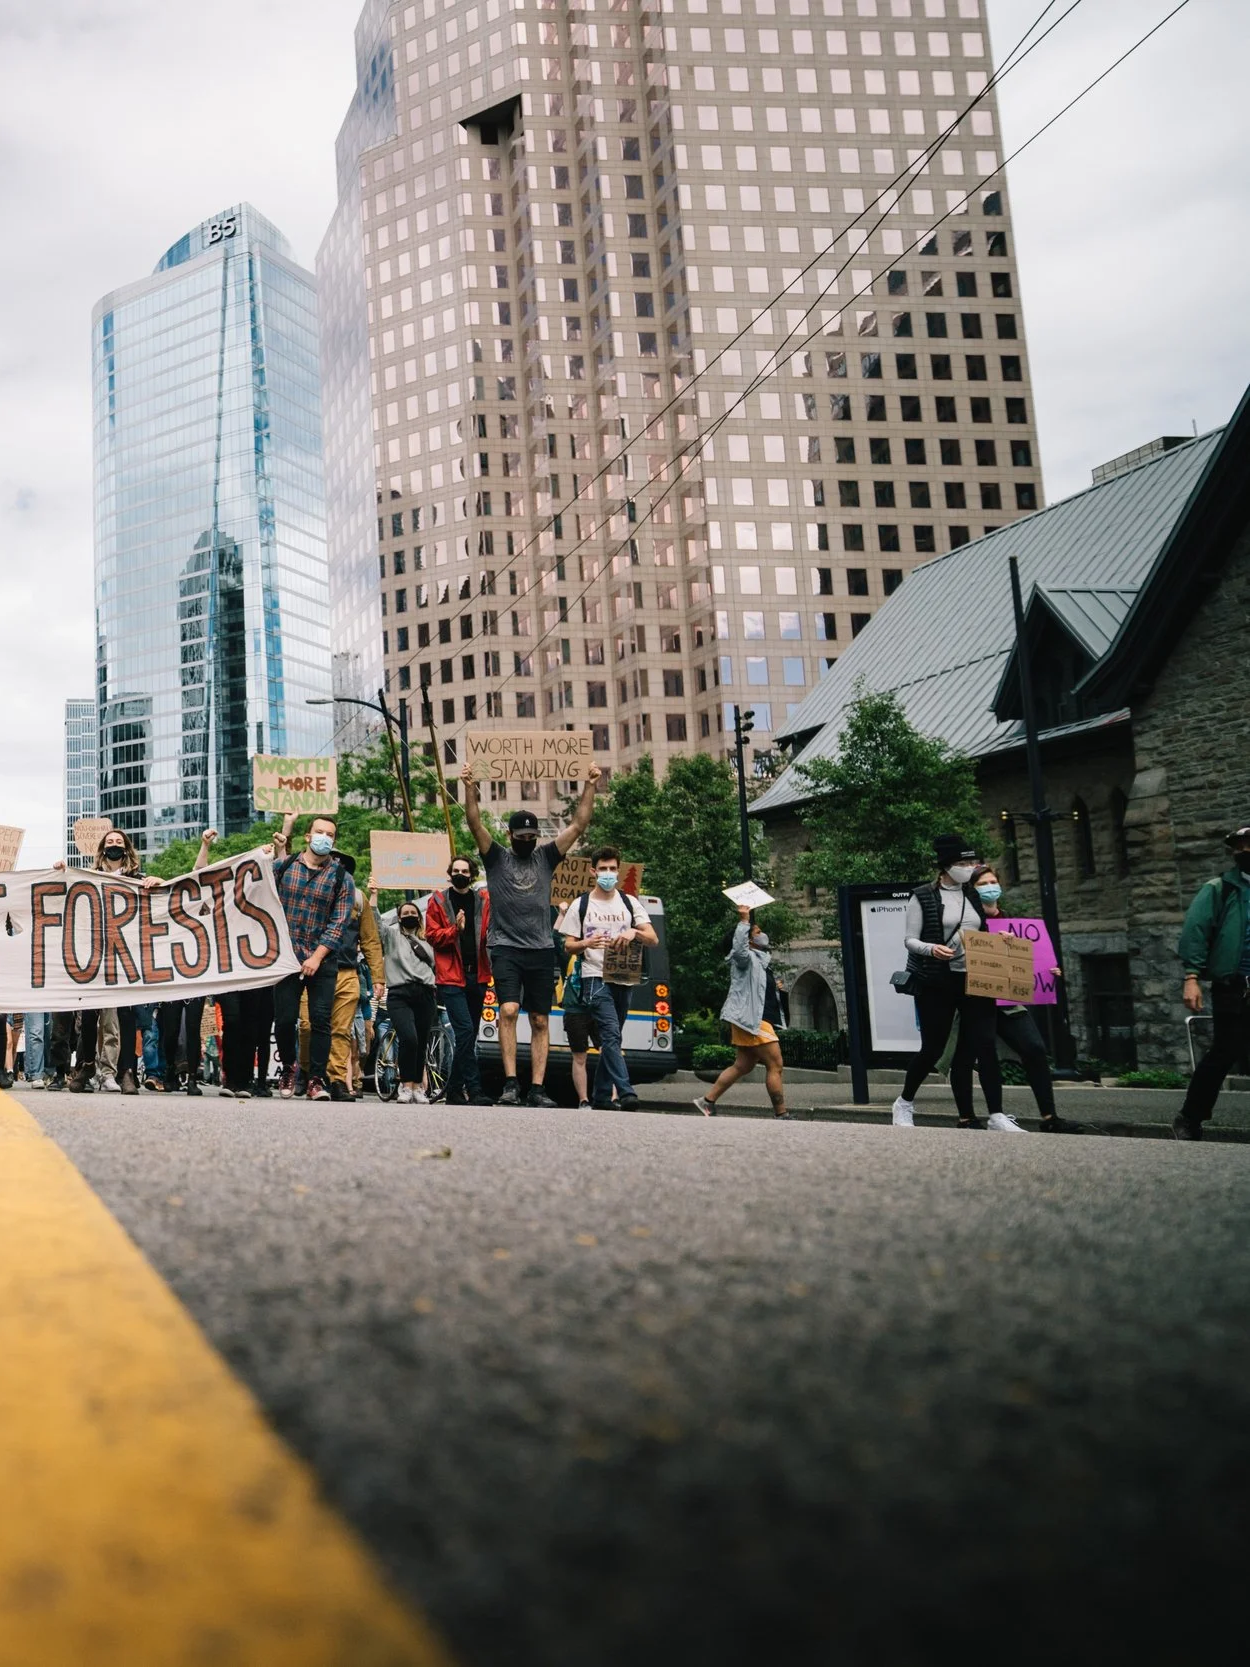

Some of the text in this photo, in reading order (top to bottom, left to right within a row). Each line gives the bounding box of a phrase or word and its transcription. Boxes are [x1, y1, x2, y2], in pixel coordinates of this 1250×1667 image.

[207, 217, 236, 245] B5
[469, 737, 590, 755] WORTH MORE
[255, 756, 330, 776] WORTH
[490, 759, 582, 779] STANDING
[277, 776, 327, 792] MORE
[552, 873, 596, 888] ANCIE
[30, 859, 281, 989] FORESTS
[1008, 923, 1040, 942] NO
[1012, 985, 1030, 997] RISK
